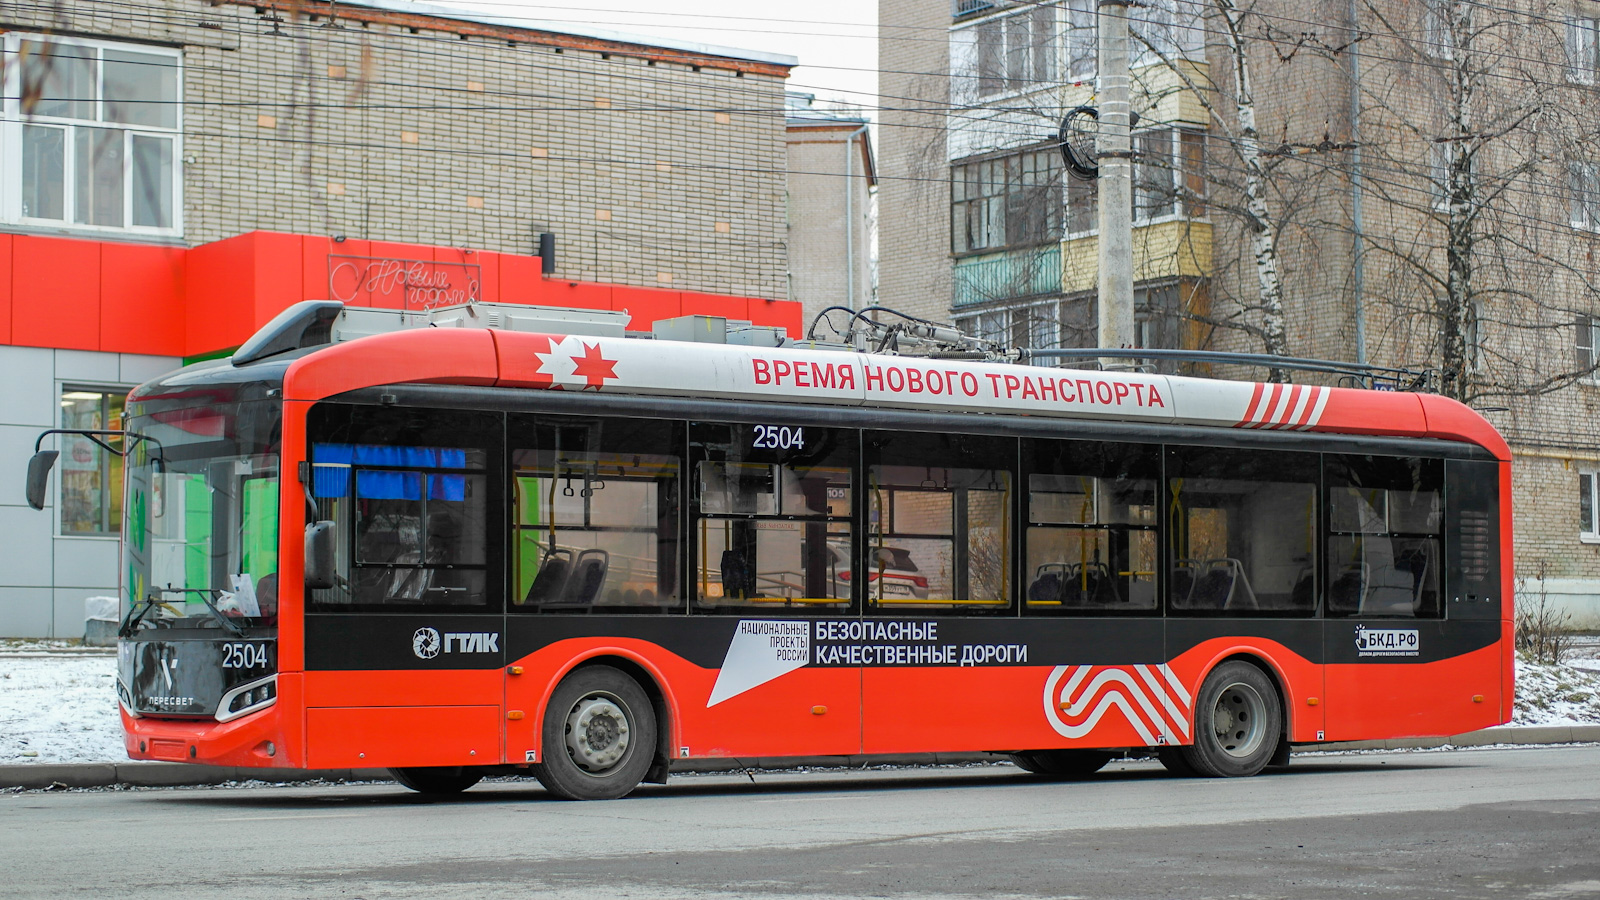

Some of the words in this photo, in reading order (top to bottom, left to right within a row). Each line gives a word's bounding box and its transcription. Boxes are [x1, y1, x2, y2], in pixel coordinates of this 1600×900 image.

[752, 358, 855, 390] ВРЕМЯ
[864, 365, 979, 397] НОВОГО
[985, 373, 1165, 408] ТРАНСПОРТА
[753, 424, 804, 450] 2504
[828, 489, 845, 498] 105
[741, 622, 808, 636] НАЦИОНАЛЬНЫЕ
[815, 621, 938, 641] БЕЗОПАСНЫЕ
[444, 632, 499, 653] ГТЛК
[770, 636, 808, 648] ПРОЕКТЫ
[1369, 633, 1416, 648] БКД.РФ
[222, 643, 268, 669] 2504
[776, 649, 808, 661] РОССИИ
[815, 645, 957, 664] КАЧЕСТВЕННЫЕ
[960, 644, 1028, 667] ДОРОГИ
[149, 696, 194, 706] ПЕРЕСВЕТ
